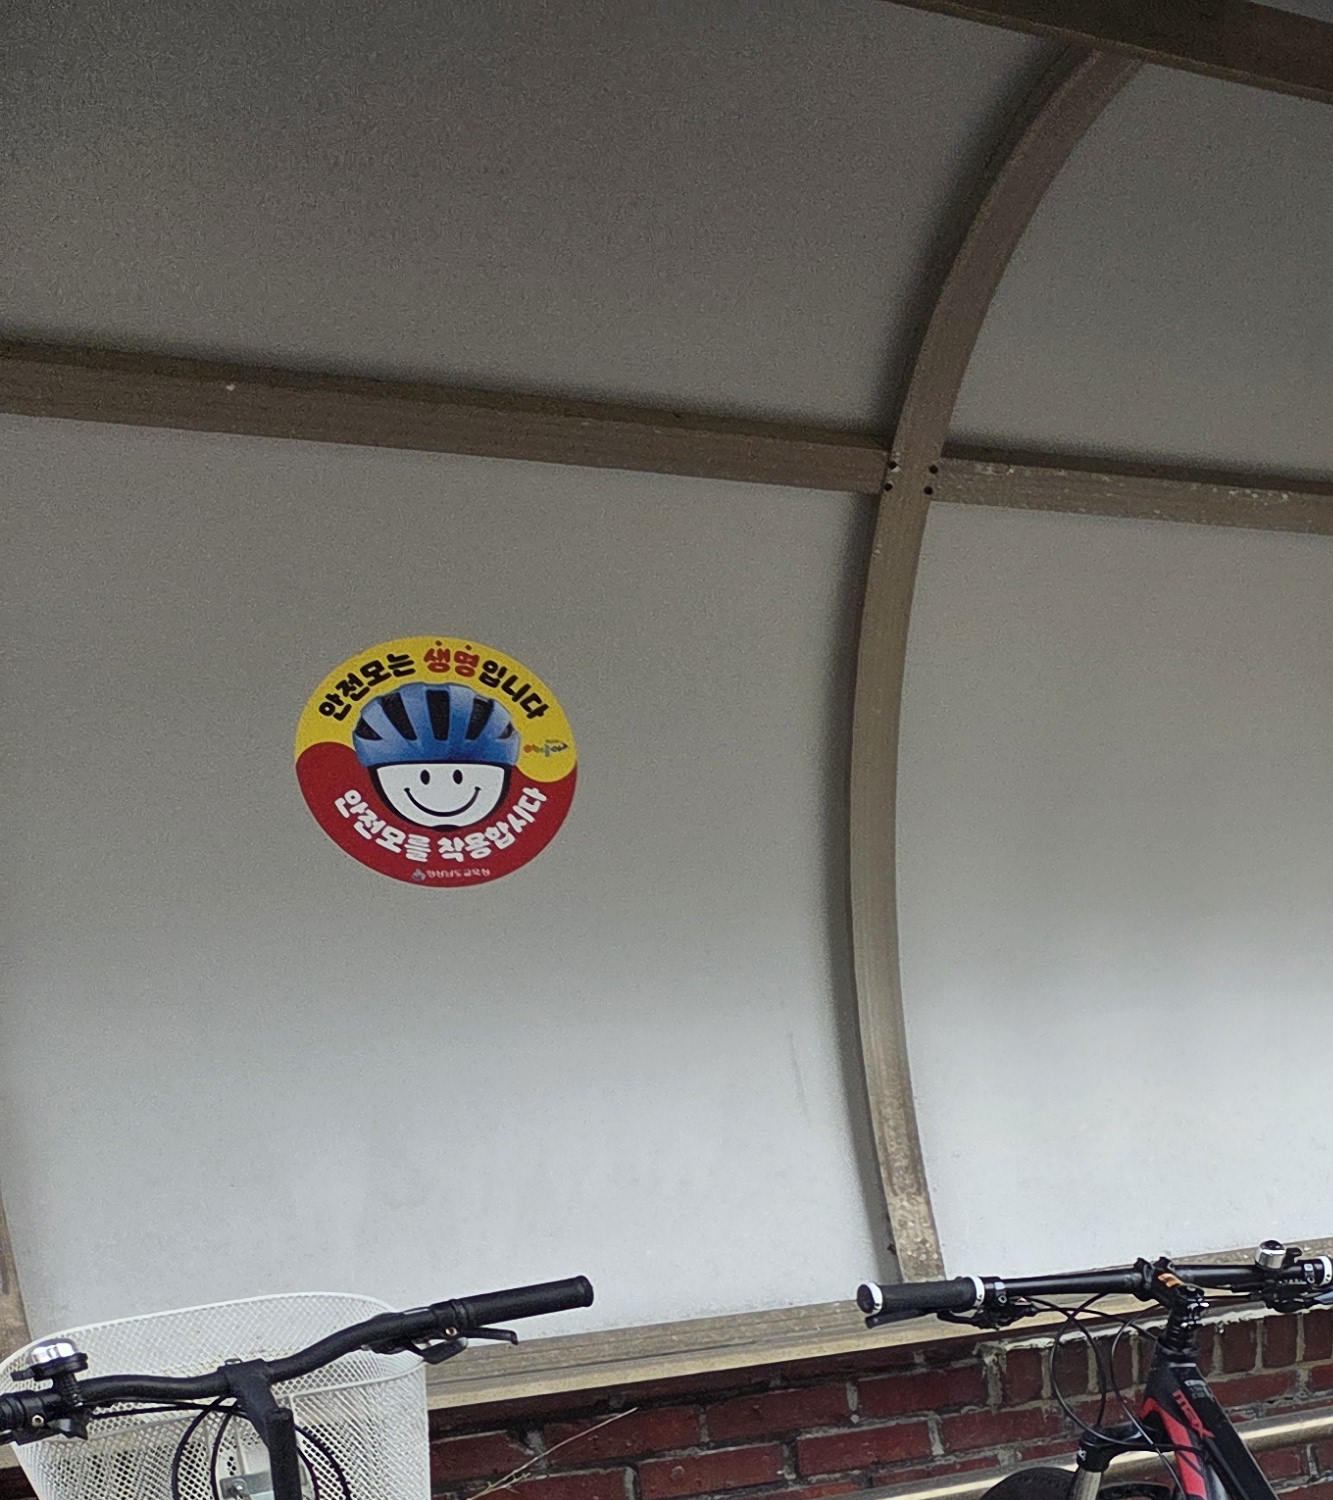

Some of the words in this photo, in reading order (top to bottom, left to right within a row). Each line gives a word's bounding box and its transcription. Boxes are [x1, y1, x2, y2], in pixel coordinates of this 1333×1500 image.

[318, 653, 415, 722] 안전모는
[423, 642, 549, 720] 생명입니다
[334, 789, 431, 862] 안전모를
[437, 787, 547, 862] 착용합시다
